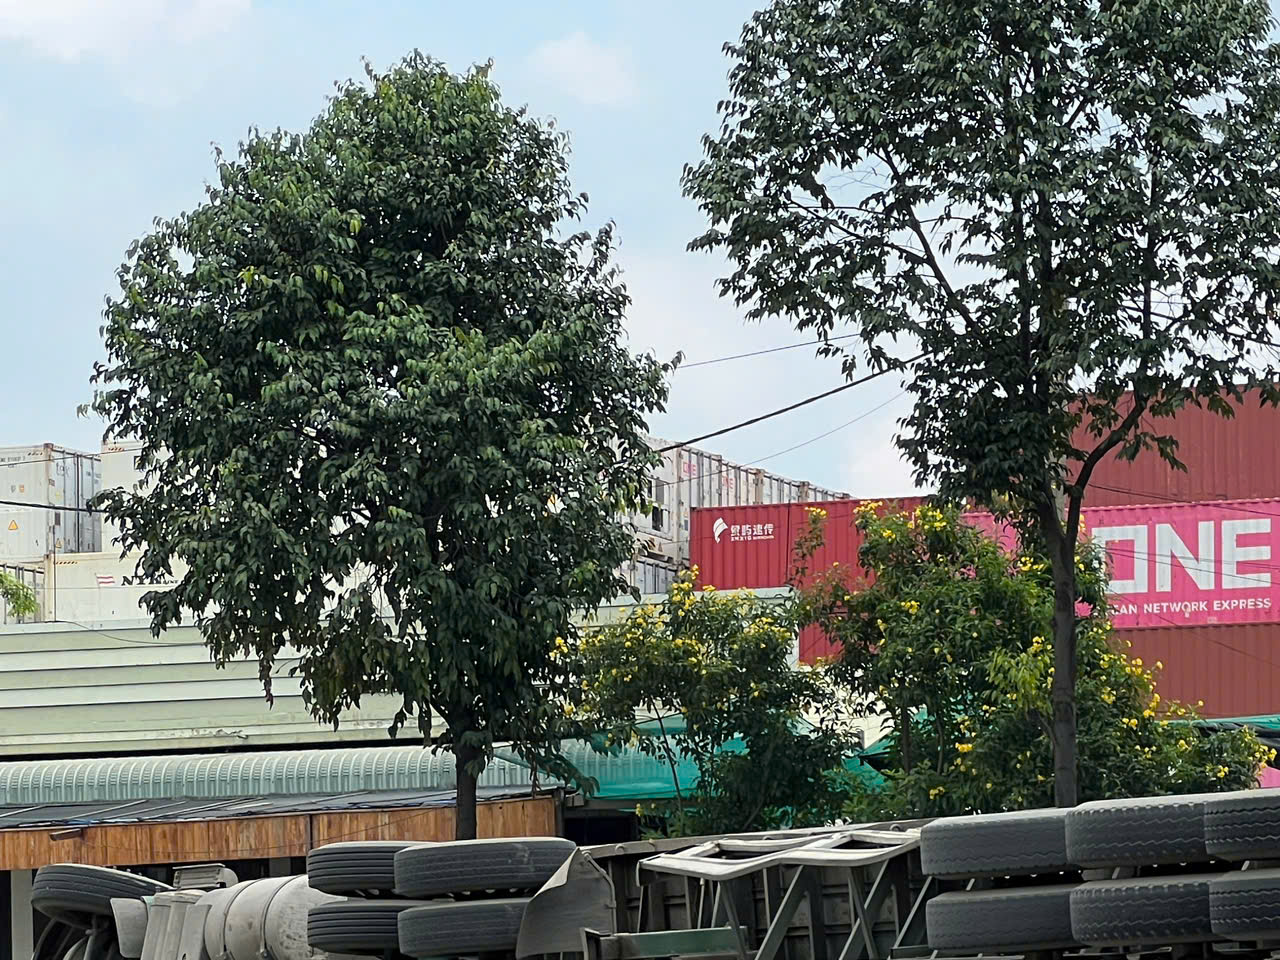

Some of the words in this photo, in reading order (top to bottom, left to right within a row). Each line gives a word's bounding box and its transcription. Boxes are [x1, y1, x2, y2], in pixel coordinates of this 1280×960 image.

[1092, 518, 1272, 594] ONE
[1143, 601, 1208, 615] NETWORK
[1213, 598, 1272, 611] EXPRESS
